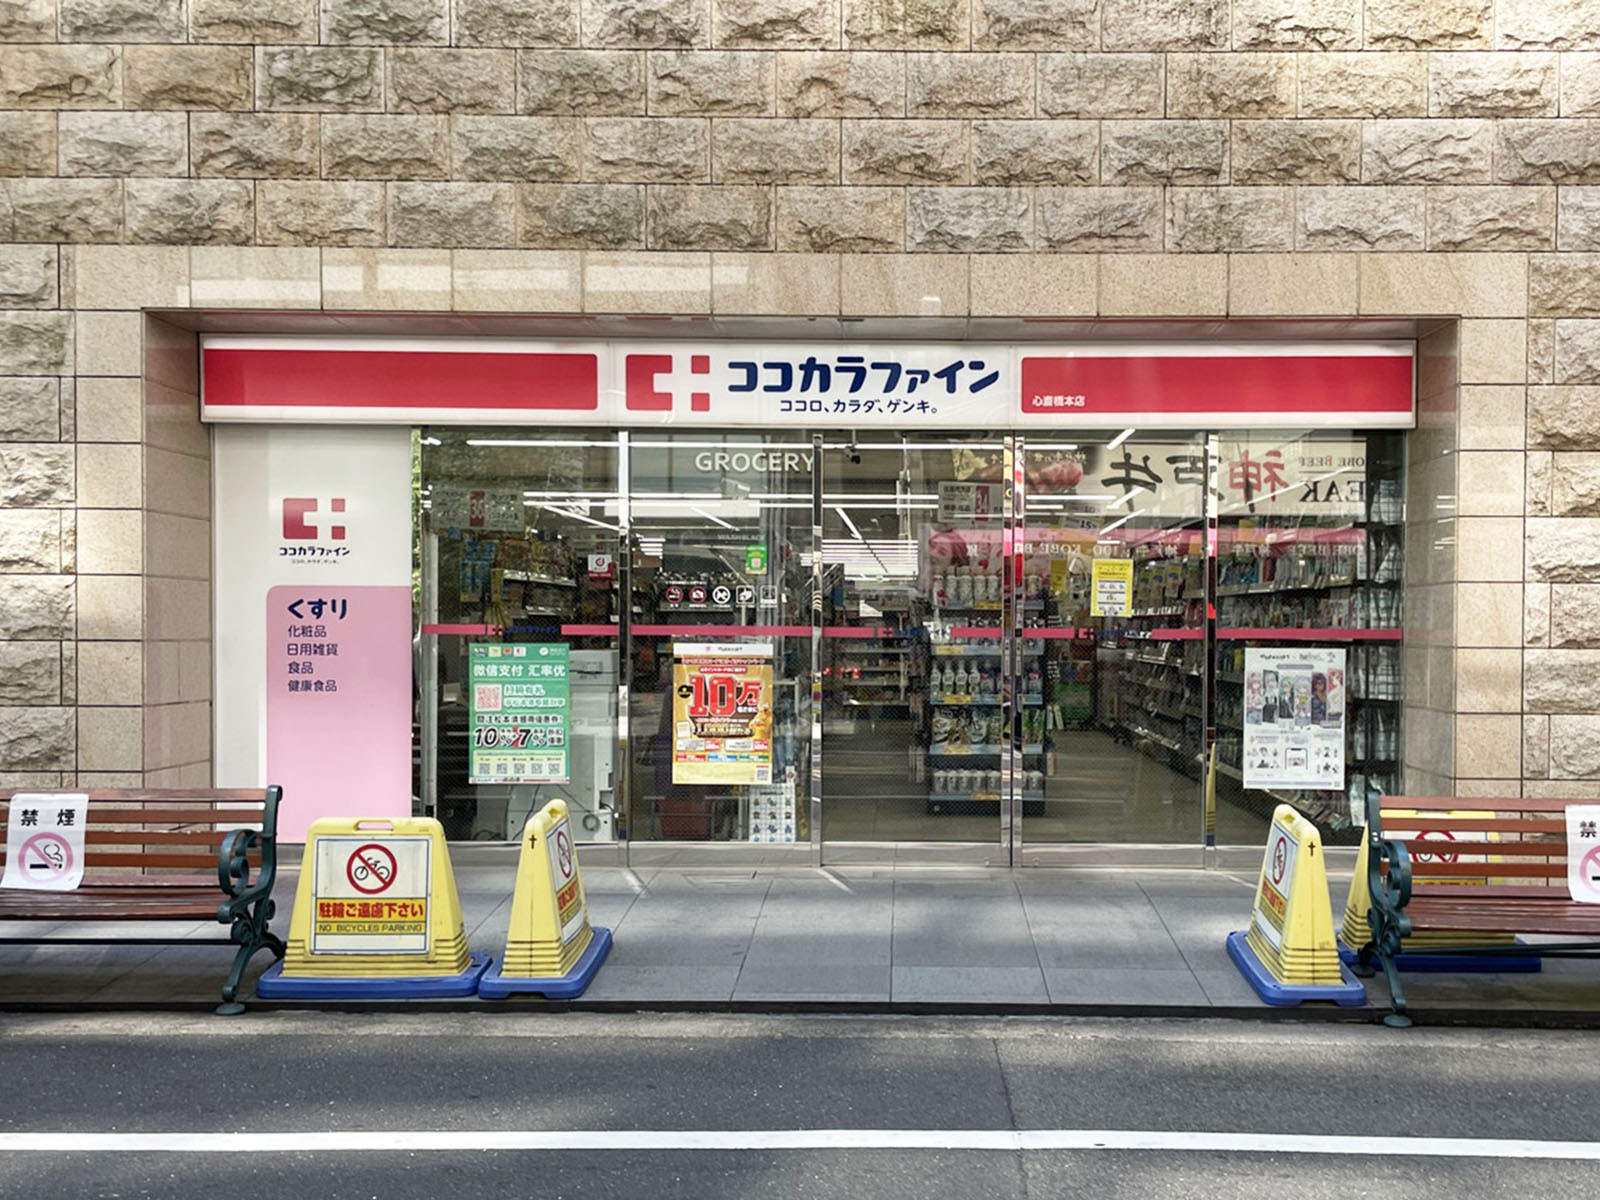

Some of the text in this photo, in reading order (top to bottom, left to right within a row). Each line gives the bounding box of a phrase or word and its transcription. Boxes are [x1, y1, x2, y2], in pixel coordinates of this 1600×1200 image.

[728, 356, 1000, 394] ココカラファイン
[780, 399, 938, 414] ココロ、カラダ、ゲンキ。
[695, 451, 815, 471] GROCERY
[280, 546, 350, 556] ココカラファイン
[287, 598, 348, 620] くすり
[288, 624, 327, 638] 化粧品
[287, 643, 338, 656] 日用雑貨
[288, 661, 314, 674] 食品
[288, 680, 337, 692] 健康食品
[21, 808, 76, 827] 禁煙
[1580, 820, 1597, 838] 禁
[319, 902, 424, 918] 駐輪ご遠慮下さい
[319, 924, 423, 932] NO BICYCLES PARKING
